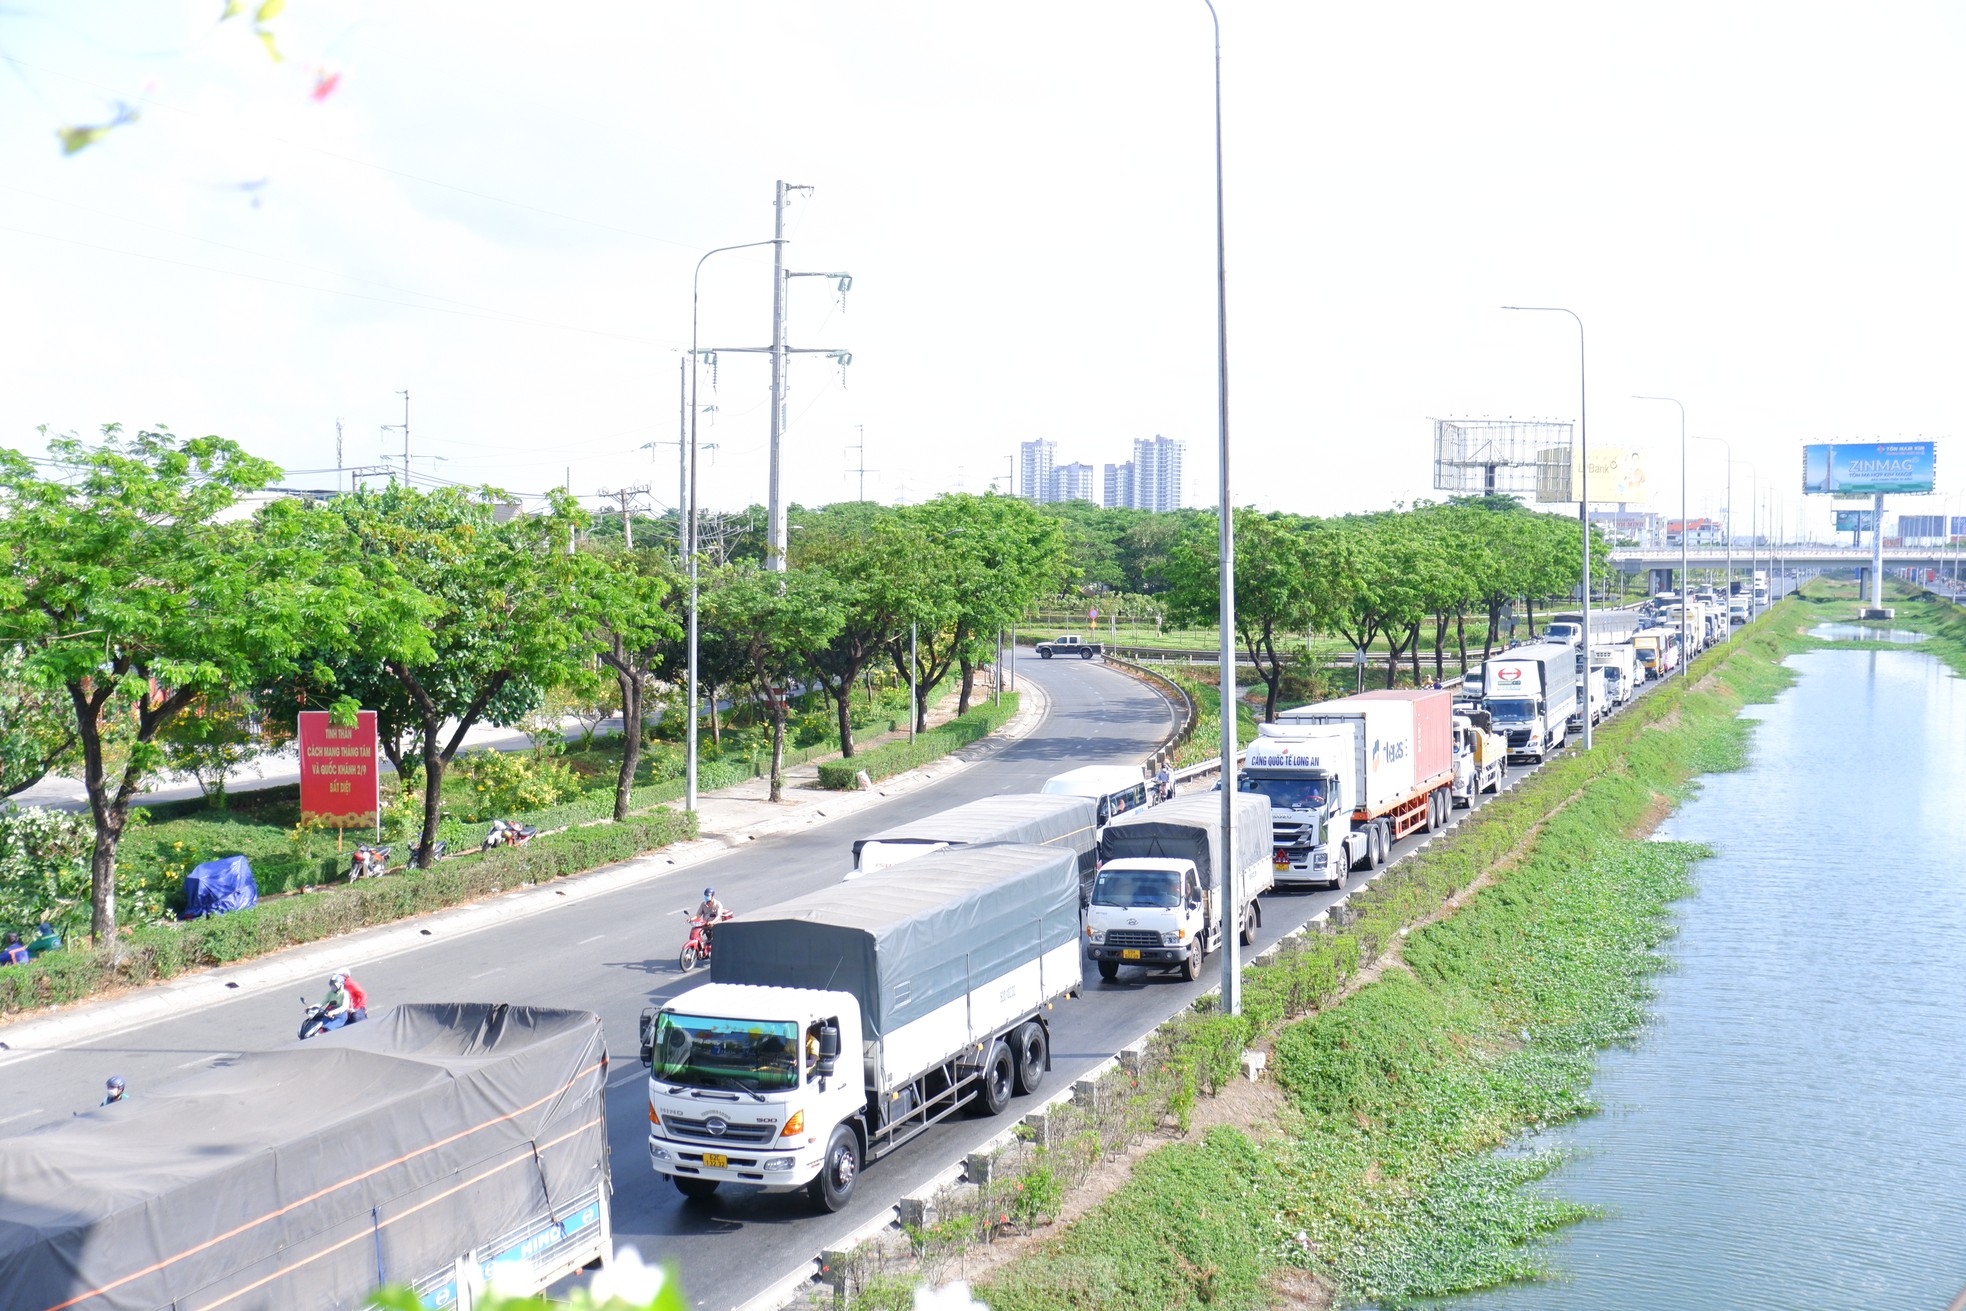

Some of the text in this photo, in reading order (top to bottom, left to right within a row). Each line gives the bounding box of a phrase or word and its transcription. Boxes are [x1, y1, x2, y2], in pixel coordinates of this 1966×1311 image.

[1578, 463, 1609, 474] LBank
[1849, 459, 1912, 472] ZINMAG
[325, 729, 337, 739] TINH
[307, 744, 371, 760] CÁCH MẠNG THÁNG TÁM
[1268, 753, 1284, 767] QUỐC
[1294, 755, 1309, 766] LONG
[1310, 756, 1320, 766] AN
[311, 760, 367, 776] VÀ QUỐC KHÁNH 2/9
[660, 1107, 683, 1116] HINO
[520, 1224, 562, 1259] HINO
